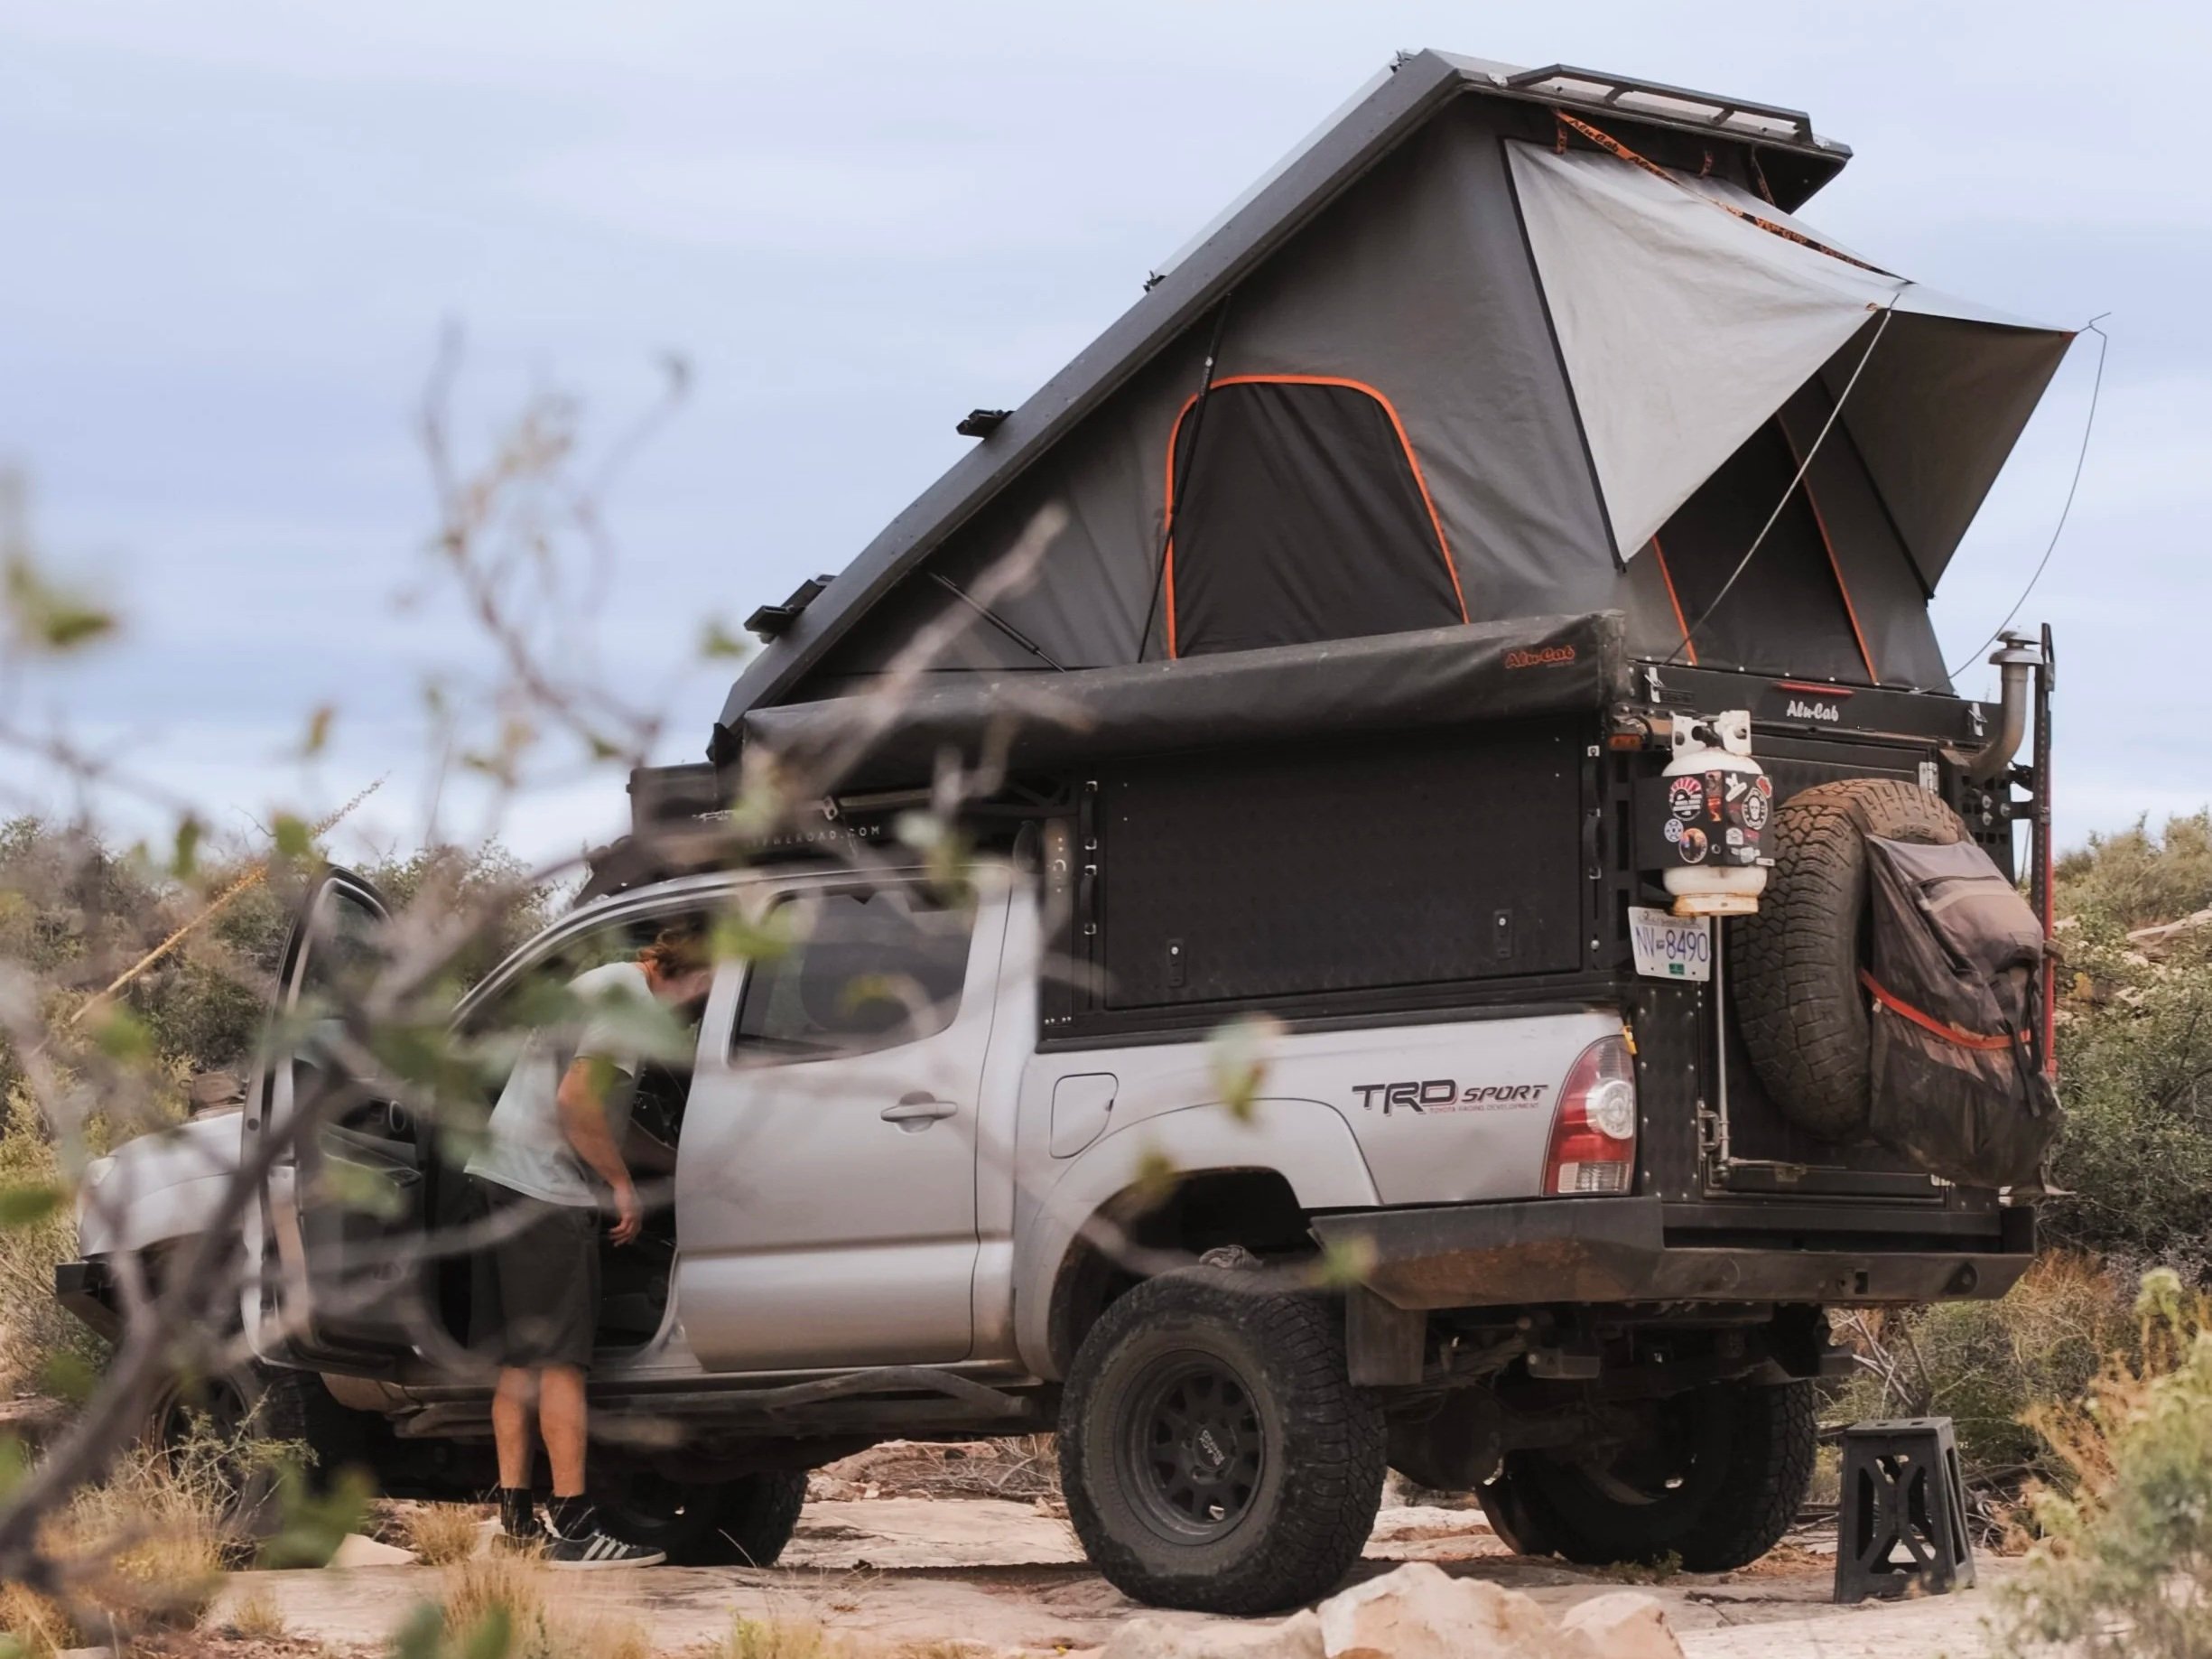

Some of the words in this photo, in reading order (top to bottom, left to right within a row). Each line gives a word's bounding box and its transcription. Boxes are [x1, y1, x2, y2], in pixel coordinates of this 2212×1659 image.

[1505, 645, 1575, 668] Alu-Cab
[1787, 700, 1839, 722] Alu-Cab
[1665, 929, 1708, 962] 8490
[1352, 1079, 1458, 1116] TRD
[1461, 1085, 1548, 1103] SPORT
